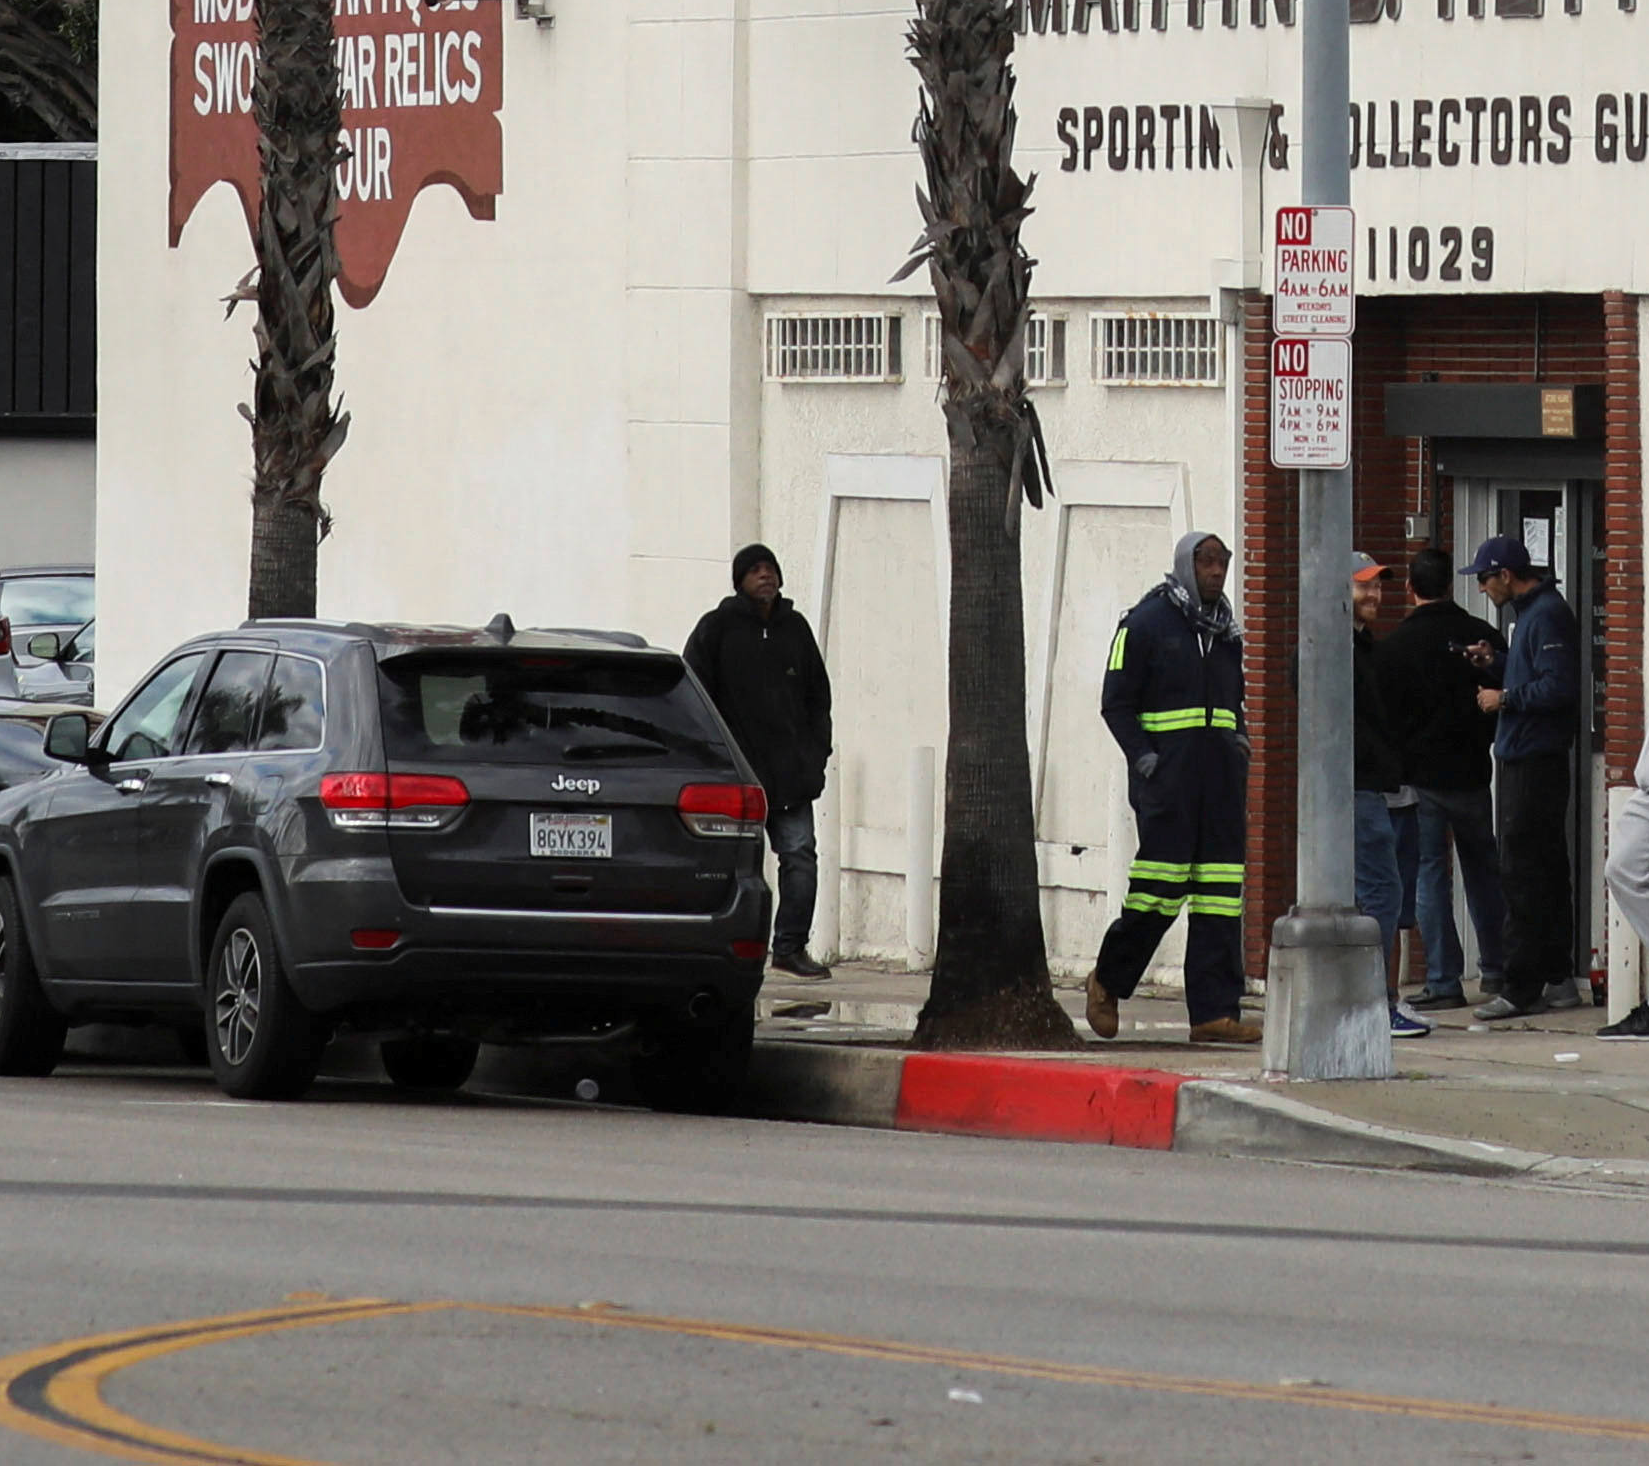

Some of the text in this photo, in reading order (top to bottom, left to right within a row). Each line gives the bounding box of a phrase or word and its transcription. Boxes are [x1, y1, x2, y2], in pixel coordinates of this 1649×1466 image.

[193, 41, 261, 115] SWO
[385, 30, 482, 108] RELICS
[1057, 104, 1234, 171] SPORTIN
[1350, 94, 1572, 169] OLLECTORS
[1281, 212, 1307, 240] NO
[1281, 250, 1347, 273] PARKING
[1368, 226, 1495, 281] 11029
[1278, 344, 1305, 371] NO
[1279, 378, 1343, 401] STOPPING
[551, 774, 600, 795] Jeep
[537, 829, 606, 849] 8GYK394
